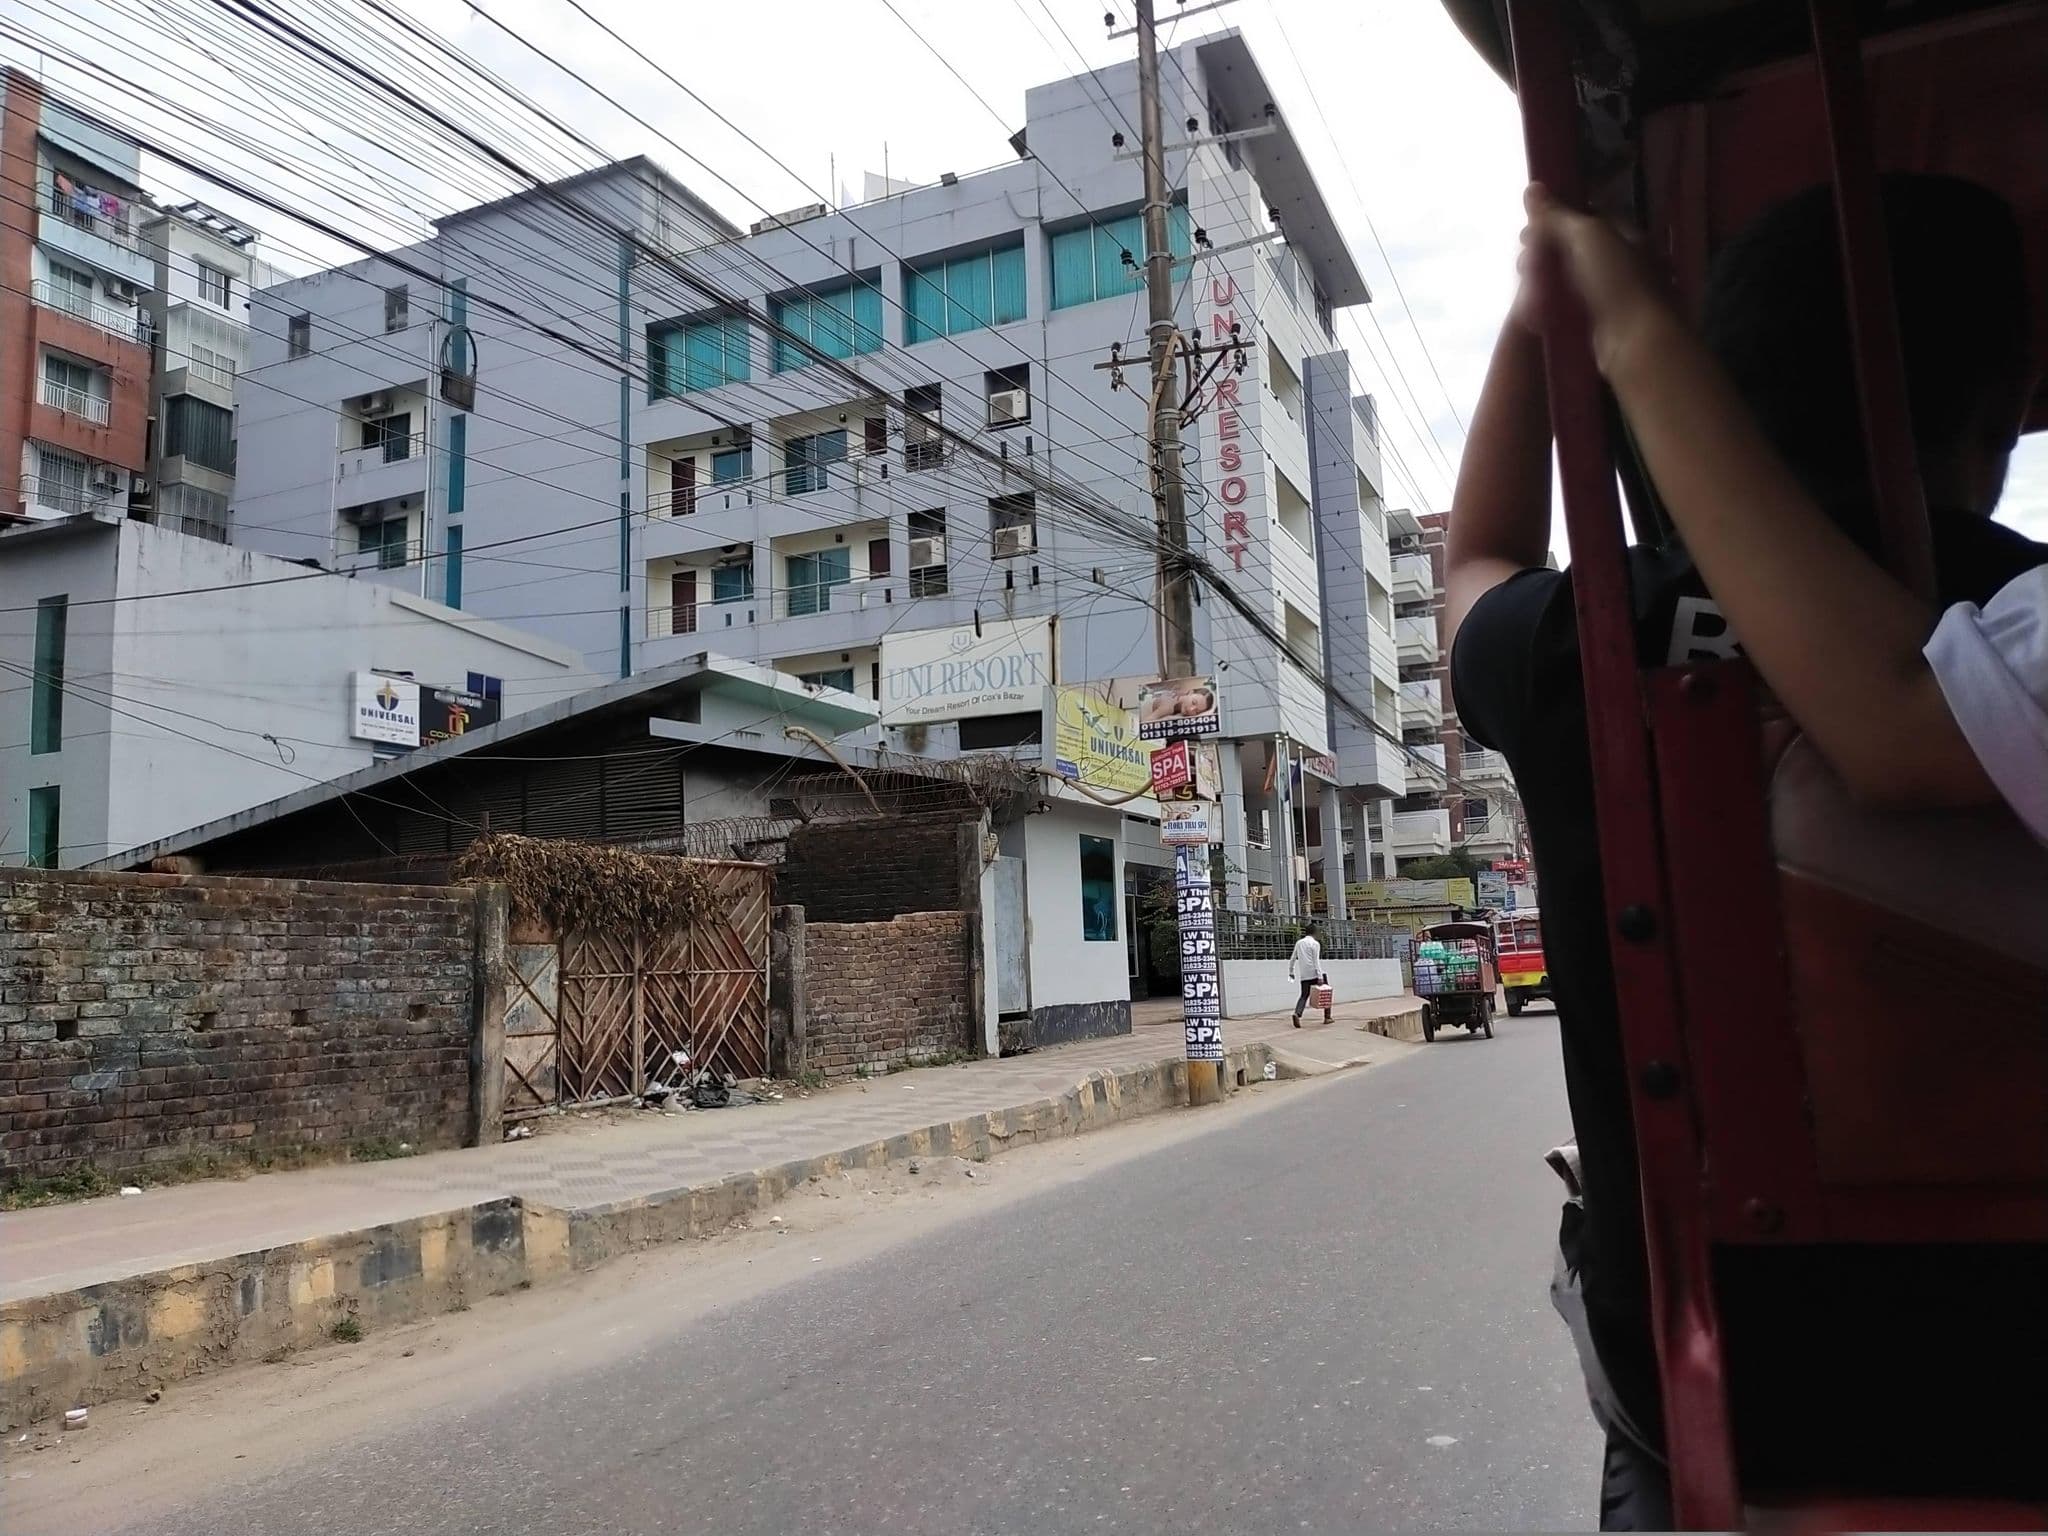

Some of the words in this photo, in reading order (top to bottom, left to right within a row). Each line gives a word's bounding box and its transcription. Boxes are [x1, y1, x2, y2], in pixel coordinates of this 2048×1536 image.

[1216, 378, 1249, 573] RESORT
[888, 664, 935, 701] UNI
[938, 652, 1044, 696] RESORT
[905, 705, 921, 715] Your
[922, 704, 946, 715] Dream
[947, 699, 970, 711] Resort
[971, 695, 980, 705] Of
[981, 693, 1002, 703] Cox's
[1003, 690, 1025, 702] Bazar
[361, 706, 416, 726] UNIVERSAL
[1141, 715, 1217, 731] 01813-805404
[1141, 724, 1217, 739] 01318-921913
[1090, 736, 1145, 766] UNIVERSAL
[1152, 754, 1185, 780] SPA
[1167, 821, 1183, 830] FLORA
[1184, 821, 1197, 830] THAI
[1197, 820, 1207, 829] SPA
[1177, 896, 1212, 913] SPA
[1182, 939, 1216, 955] SPA
[1183, 982, 1219, 998] SPA
[1186, 1027, 1222, 1043] SPA
